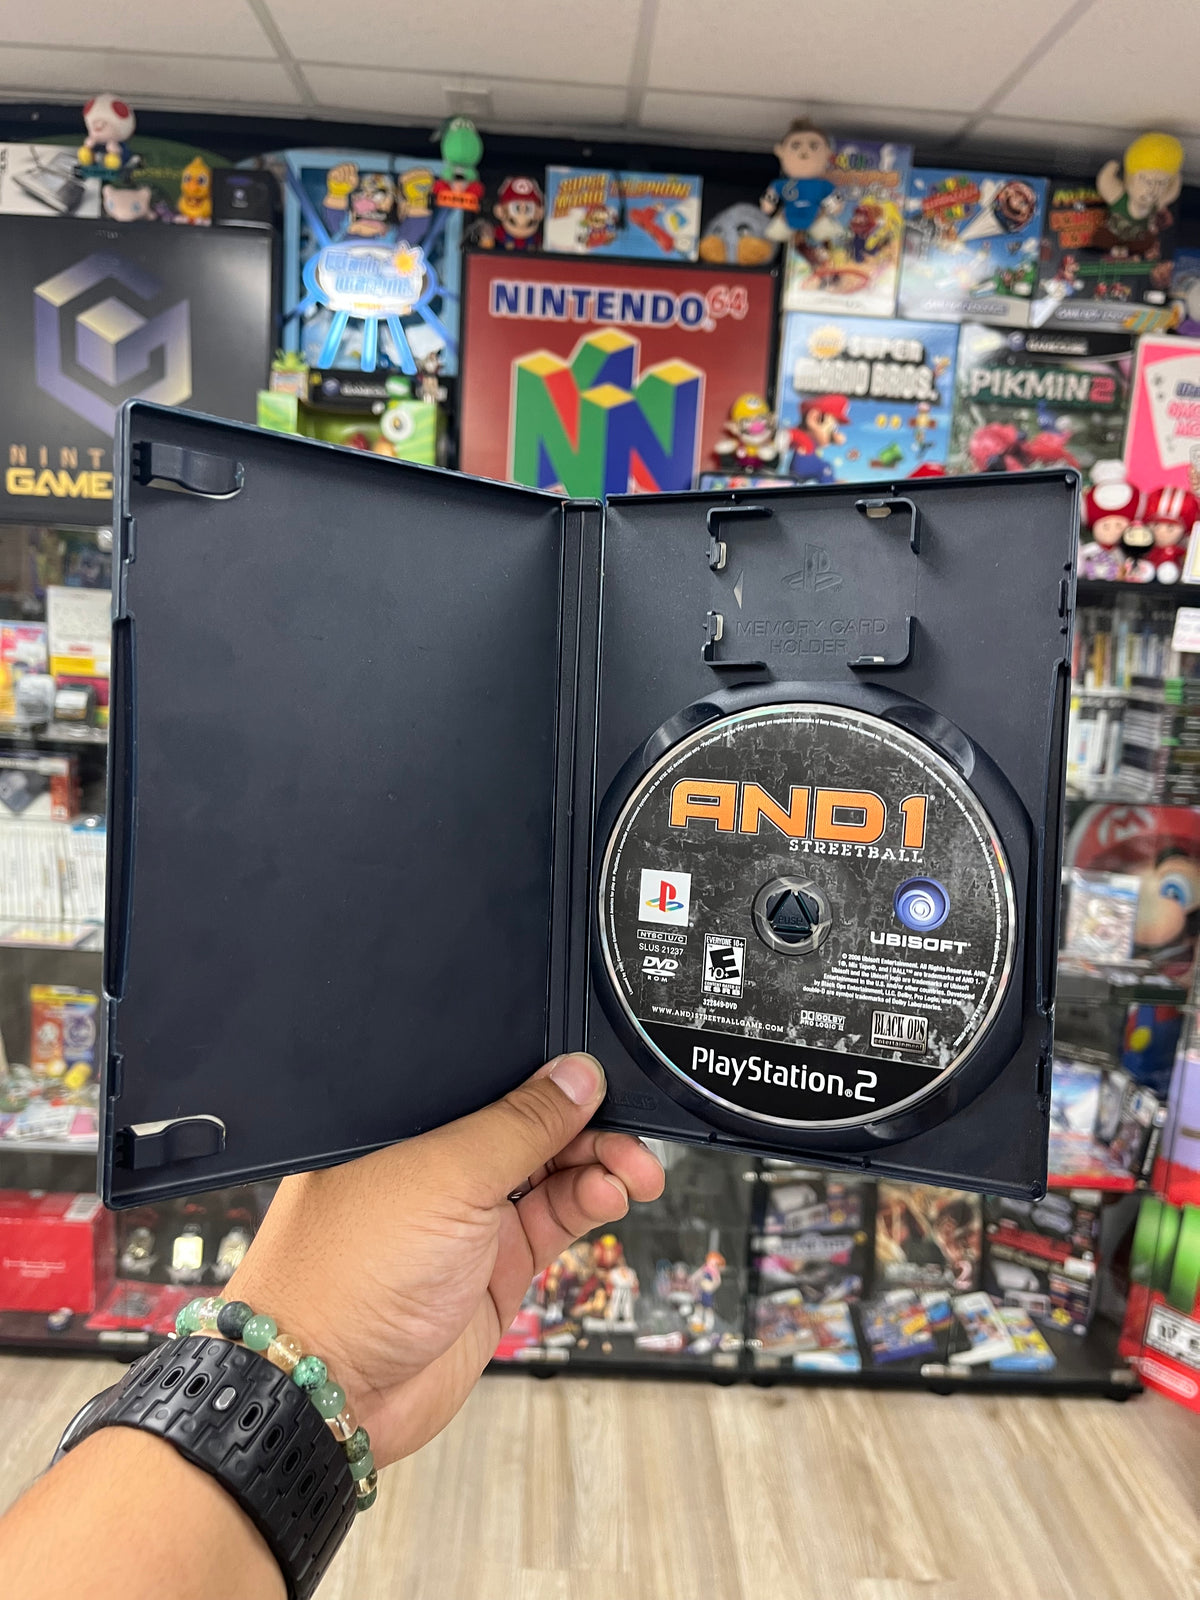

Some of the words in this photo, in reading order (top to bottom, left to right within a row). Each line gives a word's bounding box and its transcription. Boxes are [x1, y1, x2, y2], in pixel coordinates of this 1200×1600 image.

[491, 280, 706, 330] NINTENDO
[706, 284, 749, 319] 64
[969, 367, 1090, 401] PIKMIN
[1089, 375, 1115, 403] 2
[9, 444, 106, 470] NINT
[6, 467, 114, 500] GAME
[735, 619, 824, 636] MEMORY
[830, 618, 888, 635] CARD
[769, 638, 849, 656] HOLDER
[668, 777, 887, 844] AND
[899, 794, 929, 850] 1
[789, 839, 923, 862] STREETBALL
[778, 915, 803, 924] PUSH
[638, 943, 660, 952] SLUS
[661, 945, 684, 956] 21237
[733, 939, 744, 947] 10+
[870, 931, 968, 954] UBISOFT
[642, 956, 679, 970] DVD
[647, 975, 668, 983] ROM
[874, 1013, 904, 1039] BLACK
[907, 1018, 926, 1042] OPS
